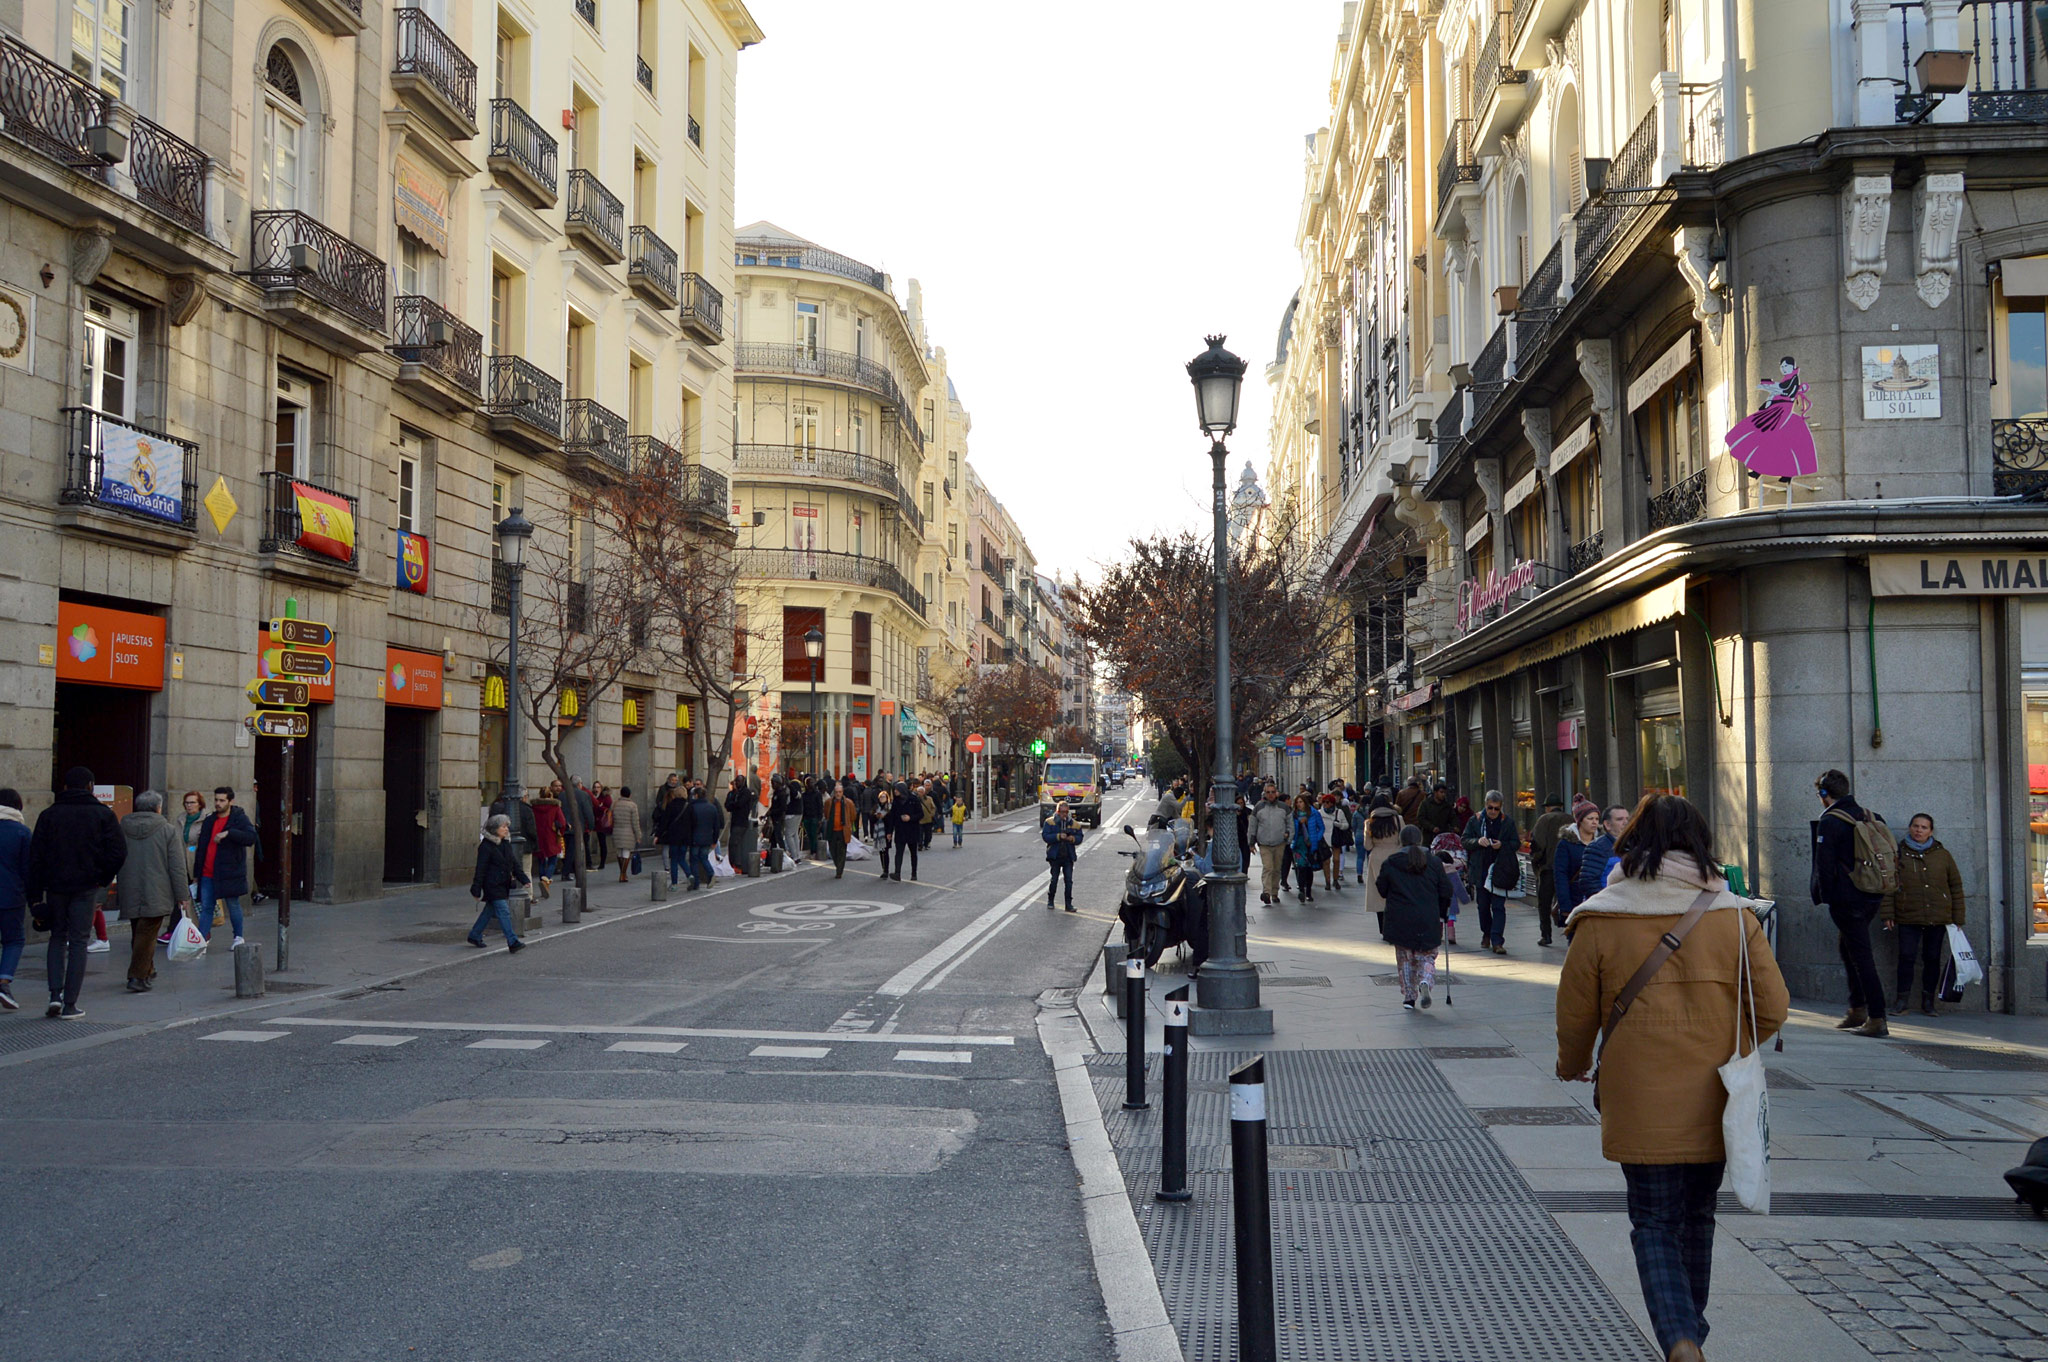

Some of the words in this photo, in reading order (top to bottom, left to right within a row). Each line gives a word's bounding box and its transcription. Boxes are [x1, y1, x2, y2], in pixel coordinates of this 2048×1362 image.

[0, 319, 16, 335] 46
[1868, 390, 1912, 401] PUERTA
[1914, 392, 1935, 400] DEL
[1888, 402, 1916, 414] SOL
[1920, 559, 1967, 589] LA
[1471, 557, 1535, 626] Mallorquina
[116, 633, 153, 647] APUESTAS
[115, 652, 139, 665] SLOTS
[414, 668, 437, 679] APUESTAS
